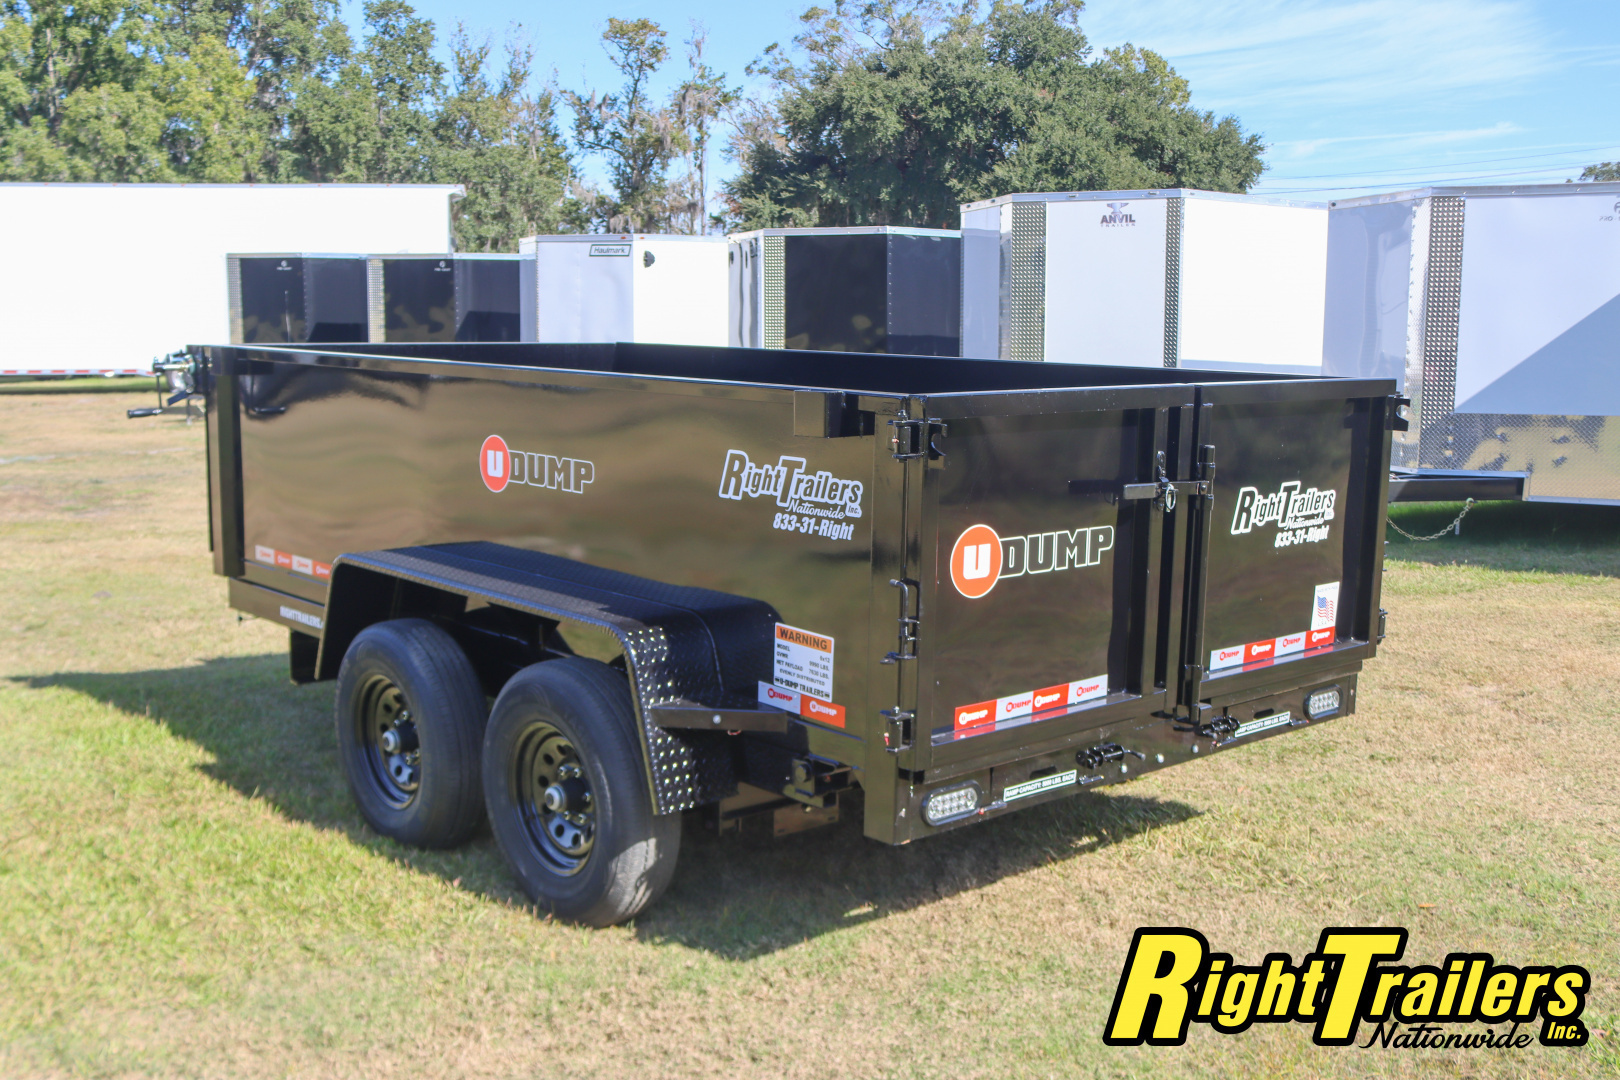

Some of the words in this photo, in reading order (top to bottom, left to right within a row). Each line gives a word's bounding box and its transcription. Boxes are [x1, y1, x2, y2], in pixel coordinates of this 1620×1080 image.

[1100, 214, 1136, 224] ANVIL
[593, 246, 625, 254] Haulmark
[785, 500, 846, 520] Nationwide
[773, 512, 855, 541] 833-31-Right
[1274, 525, 1330, 548] 833-31-Right
[780, 627, 828, 650] WARNING
[799, 683, 825, 698] TRAILERS
